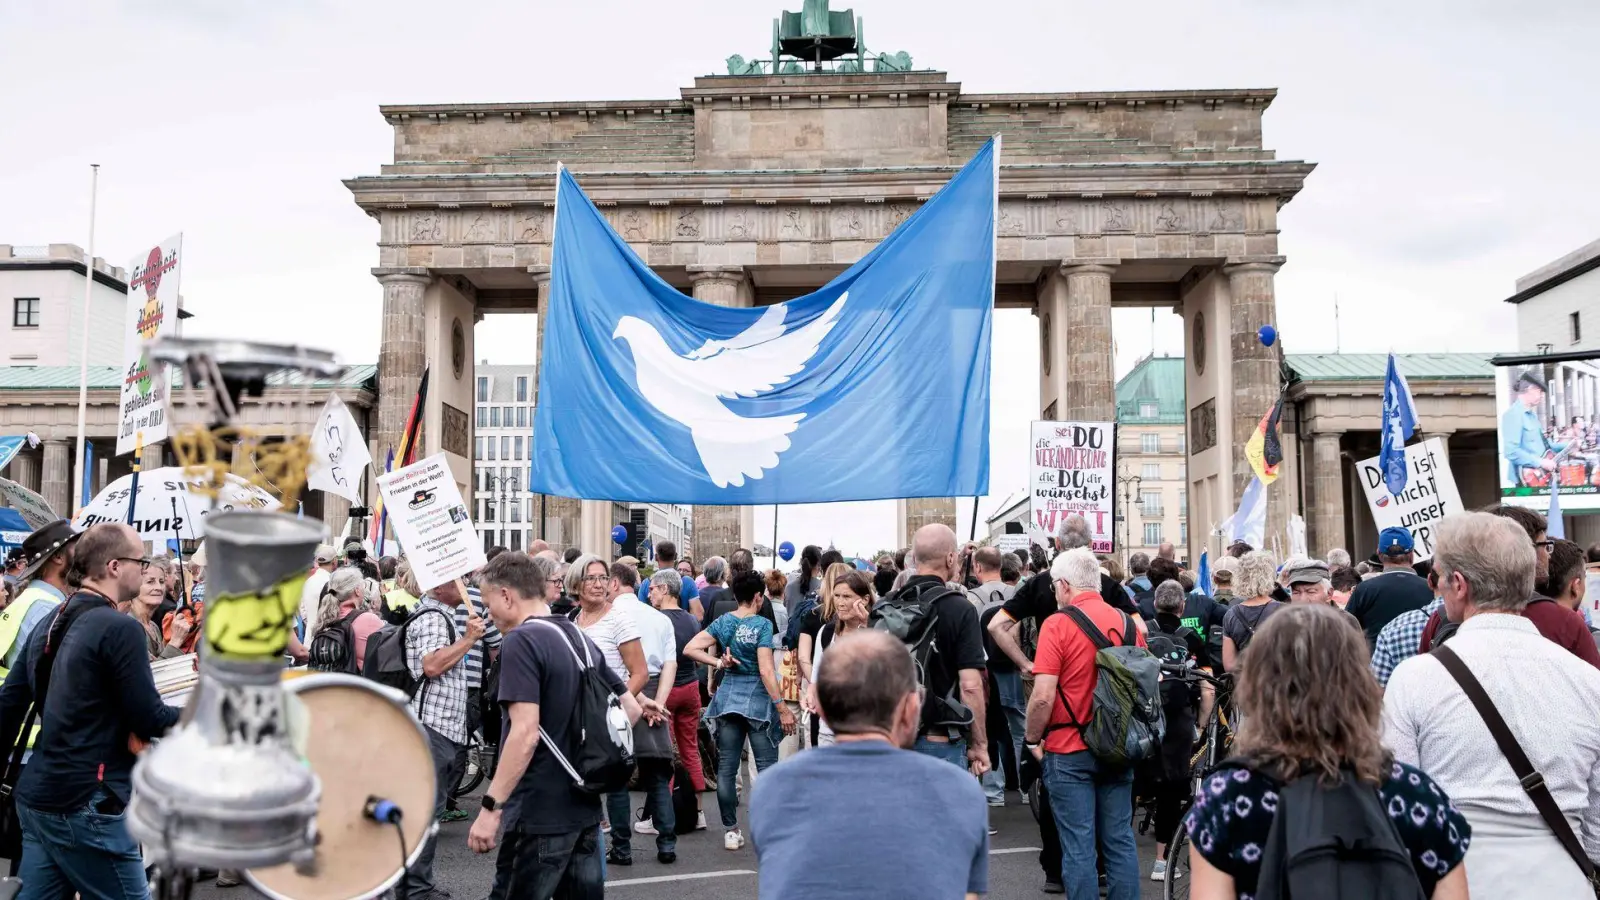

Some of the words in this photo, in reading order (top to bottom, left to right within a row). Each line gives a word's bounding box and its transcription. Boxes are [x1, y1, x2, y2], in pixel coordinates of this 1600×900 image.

[1036, 438, 1050, 448] die
[1055, 425, 1073, 437] sei
[1073, 426, 1103, 449] DU
[1036, 446, 1107, 469] VERÄNDERUNG
[1413, 452, 1438, 474] ist
[406, 469, 427, 480] Beitrag
[427, 463, 440, 472] zum
[1039, 472, 1055, 482] die
[1057, 470, 1085, 488] DU
[1087, 474, 1102, 483] dir
[389, 484, 411, 496] Frieden
[418, 478, 428, 486] der
[428, 471, 445, 481] Welt?
[1036, 485, 1109, 501] wünschst
[1394, 476, 1437, 505] nicht
[1046, 499, 1063, 511] für
[1066, 501, 1099, 510] unsere
[1400, 501, 1446, 527] unser
[1036, 509, 1108, 534] WT
